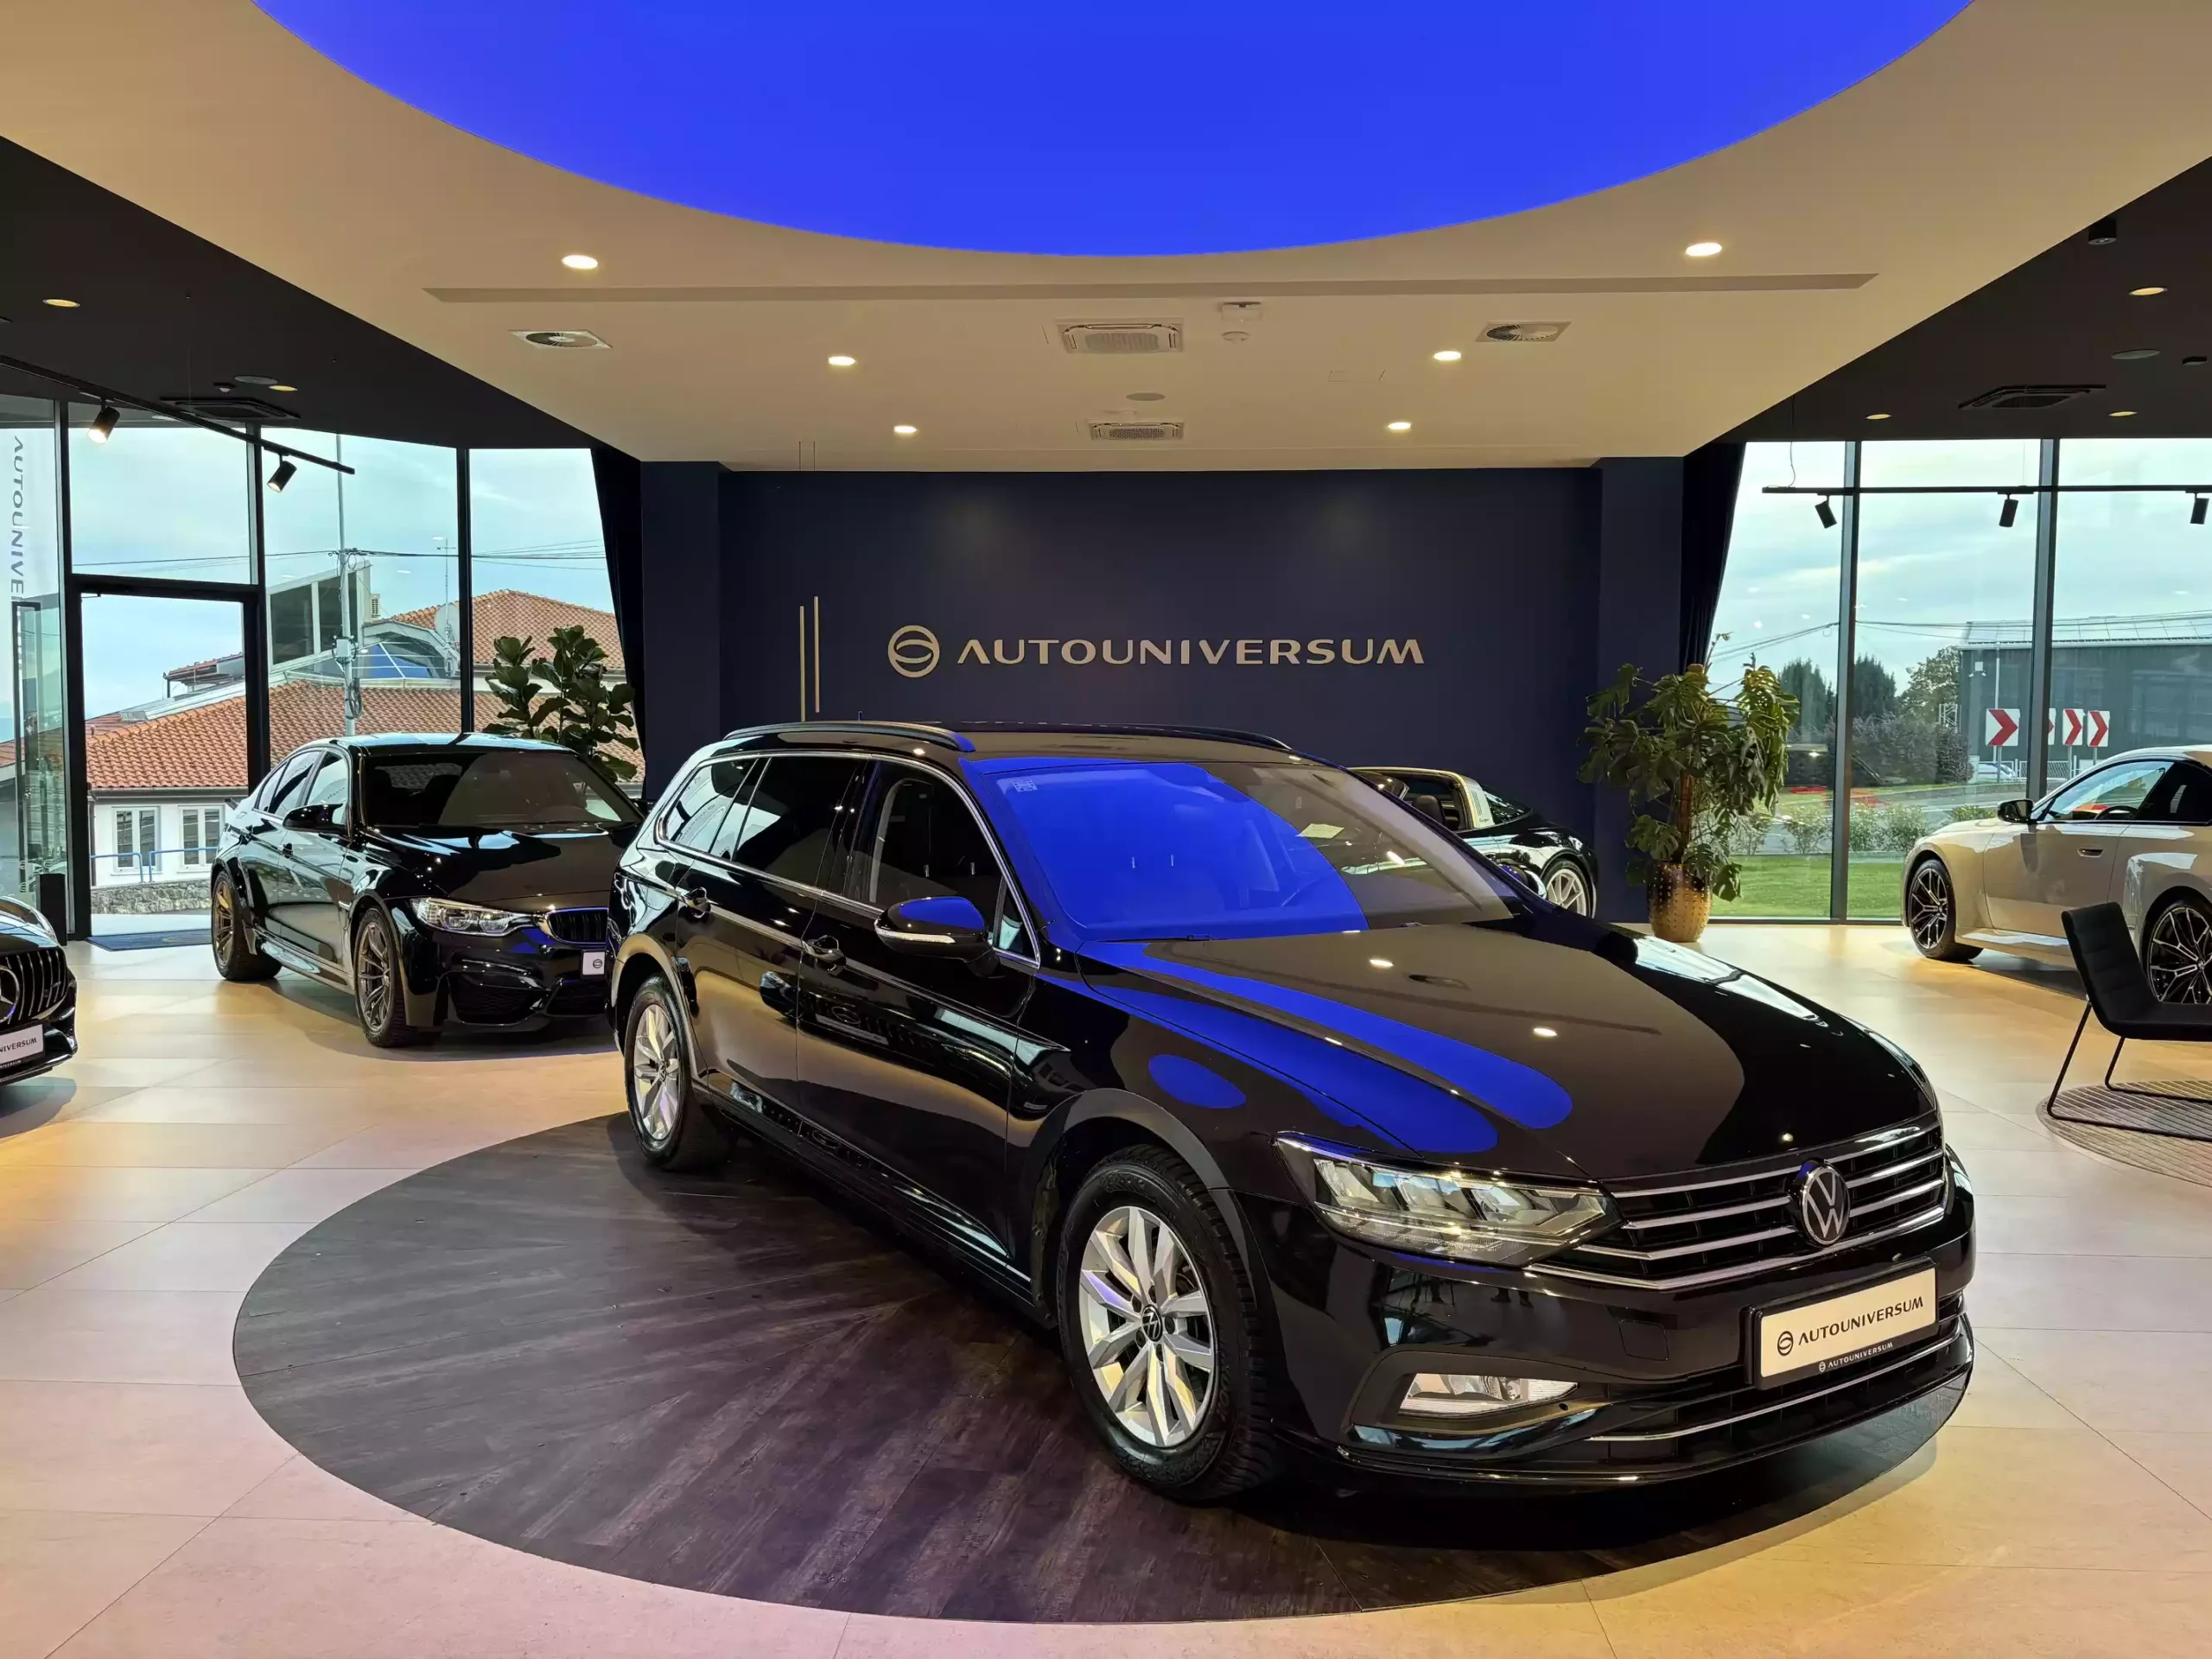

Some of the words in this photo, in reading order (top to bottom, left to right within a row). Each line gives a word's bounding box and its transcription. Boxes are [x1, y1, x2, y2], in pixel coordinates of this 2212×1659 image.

[957, 639, 1426, 664] AUTOUNIVERSUM
[1798, 1295, 1924, 1346] AUTOUNIVERSUM
[1827, 1341, 1893, 1369] AUTOUNIVERSUM
